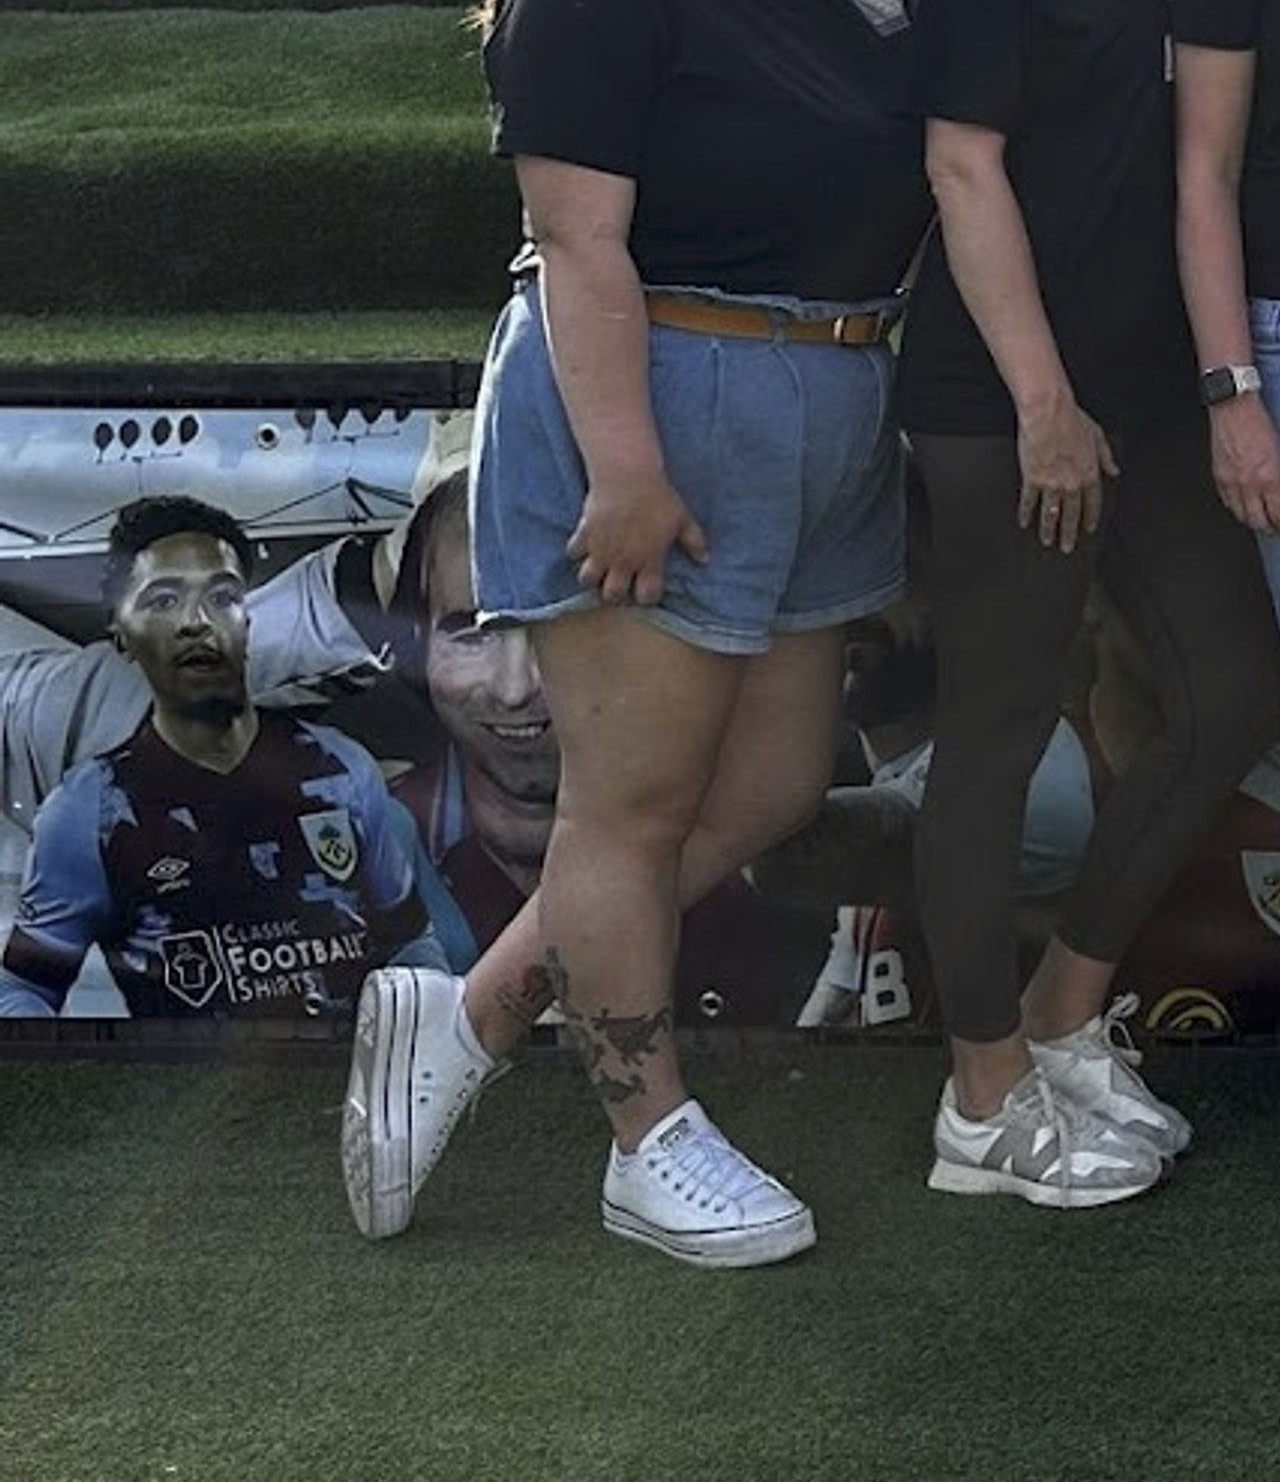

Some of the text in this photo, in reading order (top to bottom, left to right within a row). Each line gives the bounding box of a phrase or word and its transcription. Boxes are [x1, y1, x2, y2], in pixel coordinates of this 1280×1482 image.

[222, 920, 301, 944] CLASSIC
[227, 930, 367, 976] FOOTBALL
[236, 970, 319, 1001] SHIRTS
